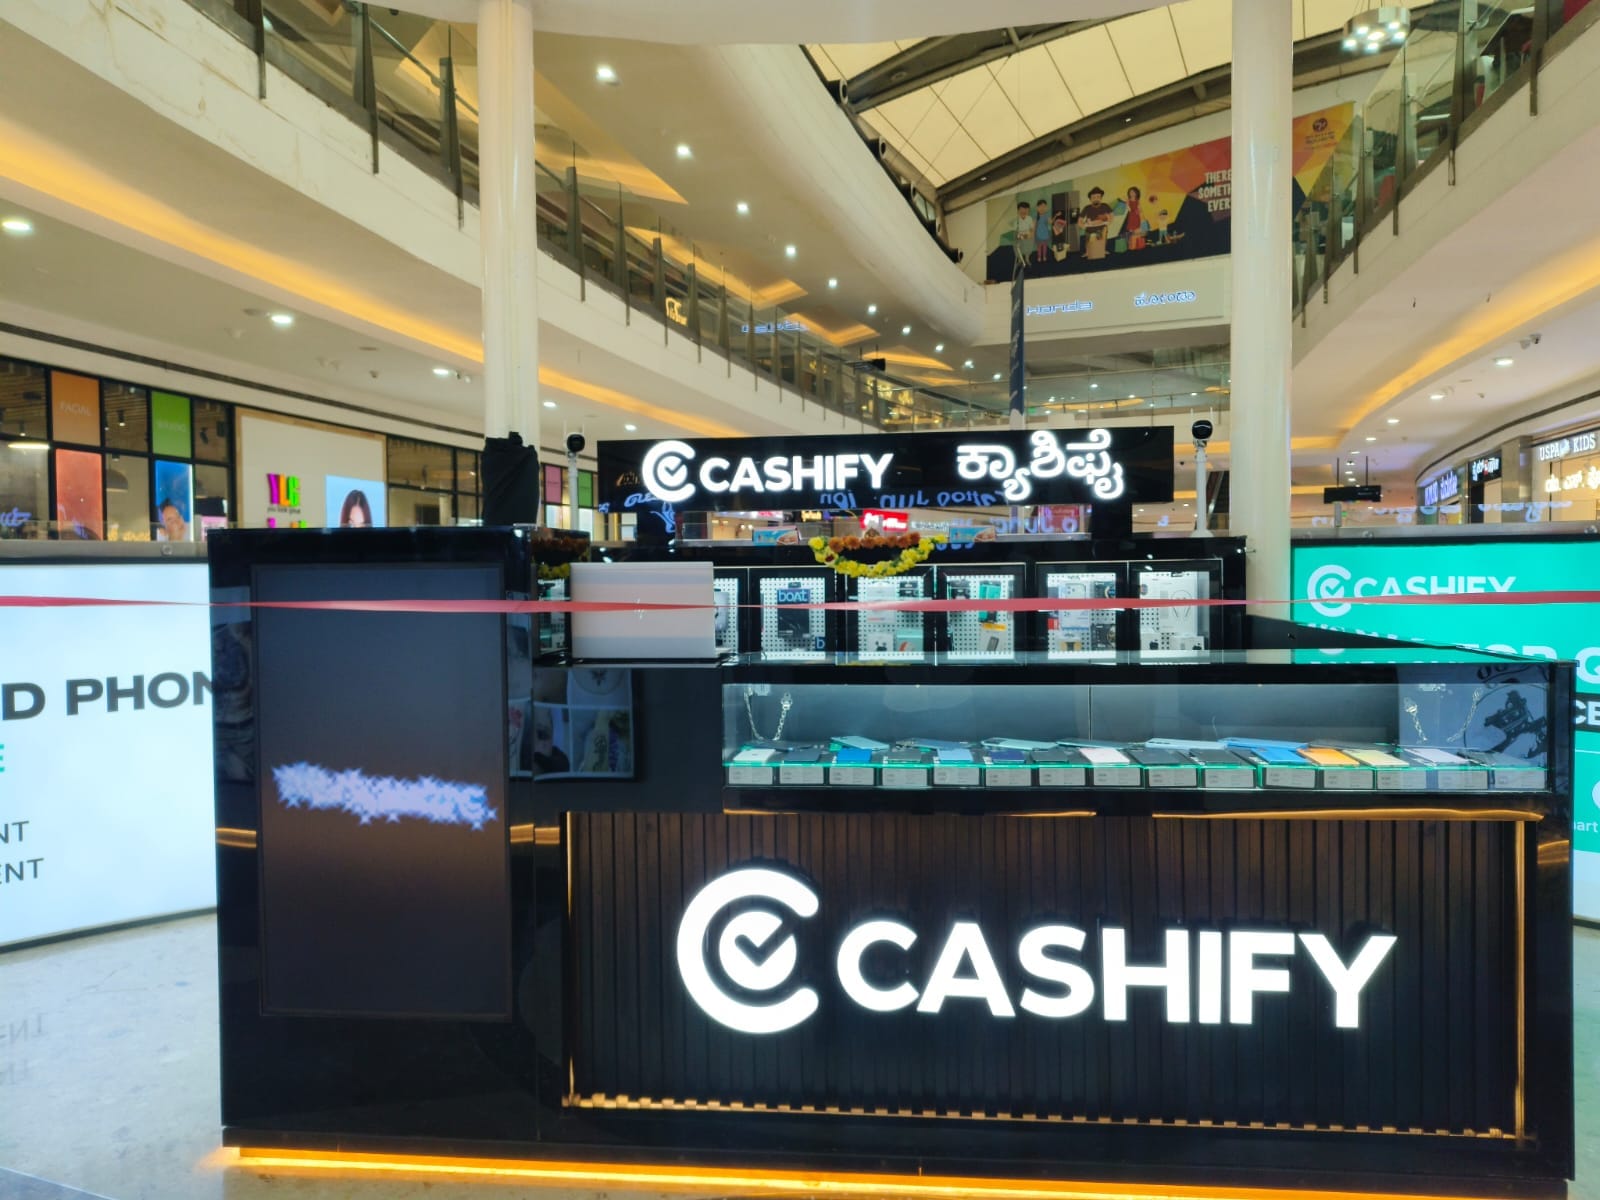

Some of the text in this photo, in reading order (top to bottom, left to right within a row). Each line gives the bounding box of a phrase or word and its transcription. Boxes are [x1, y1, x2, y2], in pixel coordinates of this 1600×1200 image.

[1207, 198, 1231, 212] EVER
[1573, 432, 1596, 453] KIDS
[699, 453, 894, 493] CASHIFY
[66, 671, 213, 716] PHON
[837, 920, 1398, 1028] CASHIFY
